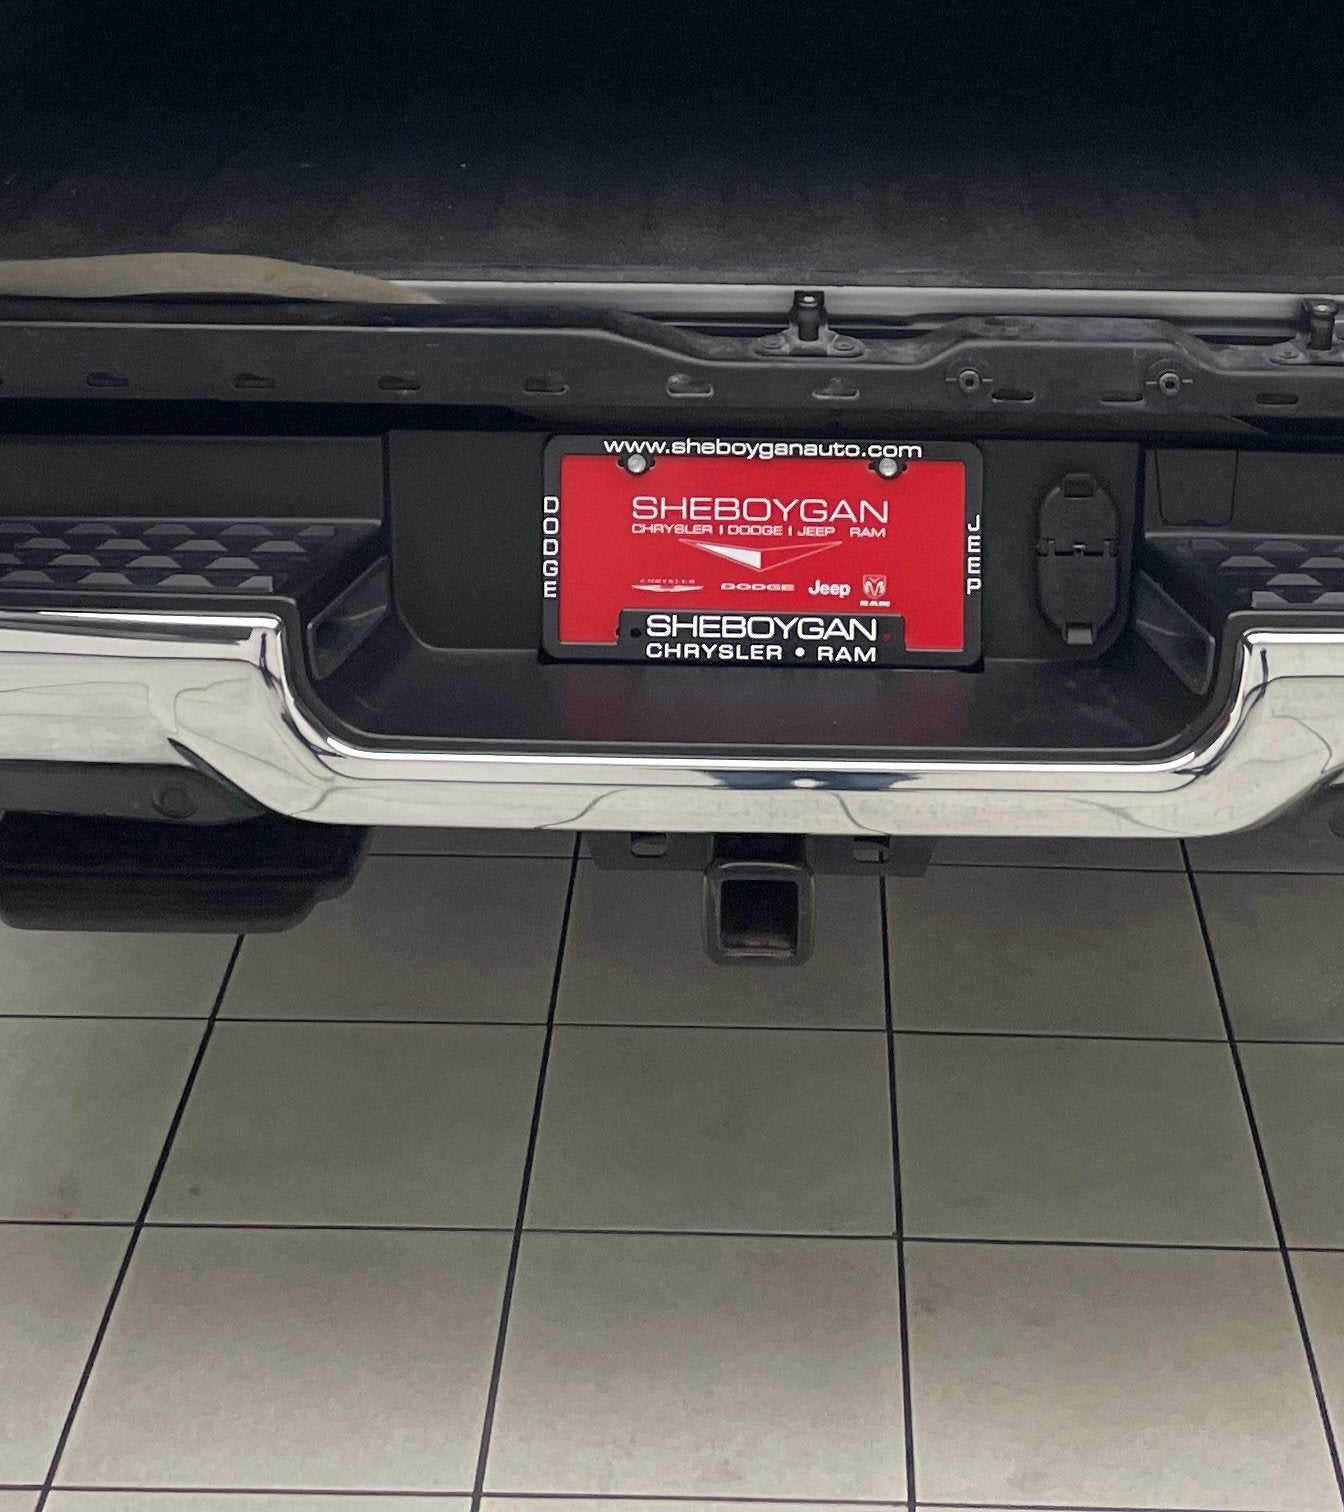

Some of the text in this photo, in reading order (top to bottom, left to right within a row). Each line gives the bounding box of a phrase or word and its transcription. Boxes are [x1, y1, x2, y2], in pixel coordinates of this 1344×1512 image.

[604, 438, 922, 460] www.sheboyganauto.com
[632, 496, 889, 524] SHEBOYGAN
[631, 522, 887, 538] CHRYSLER DODGE JEEP RAM
[543, 496, 560, 598] DODGE
[967, 515, 982, 595] JEEP
[807, 579, 852, 599] Jeep
[645, 614, 877, 641] SHEBOYGAN
[645, 642, 877, 663] CHRYSLER RAM
